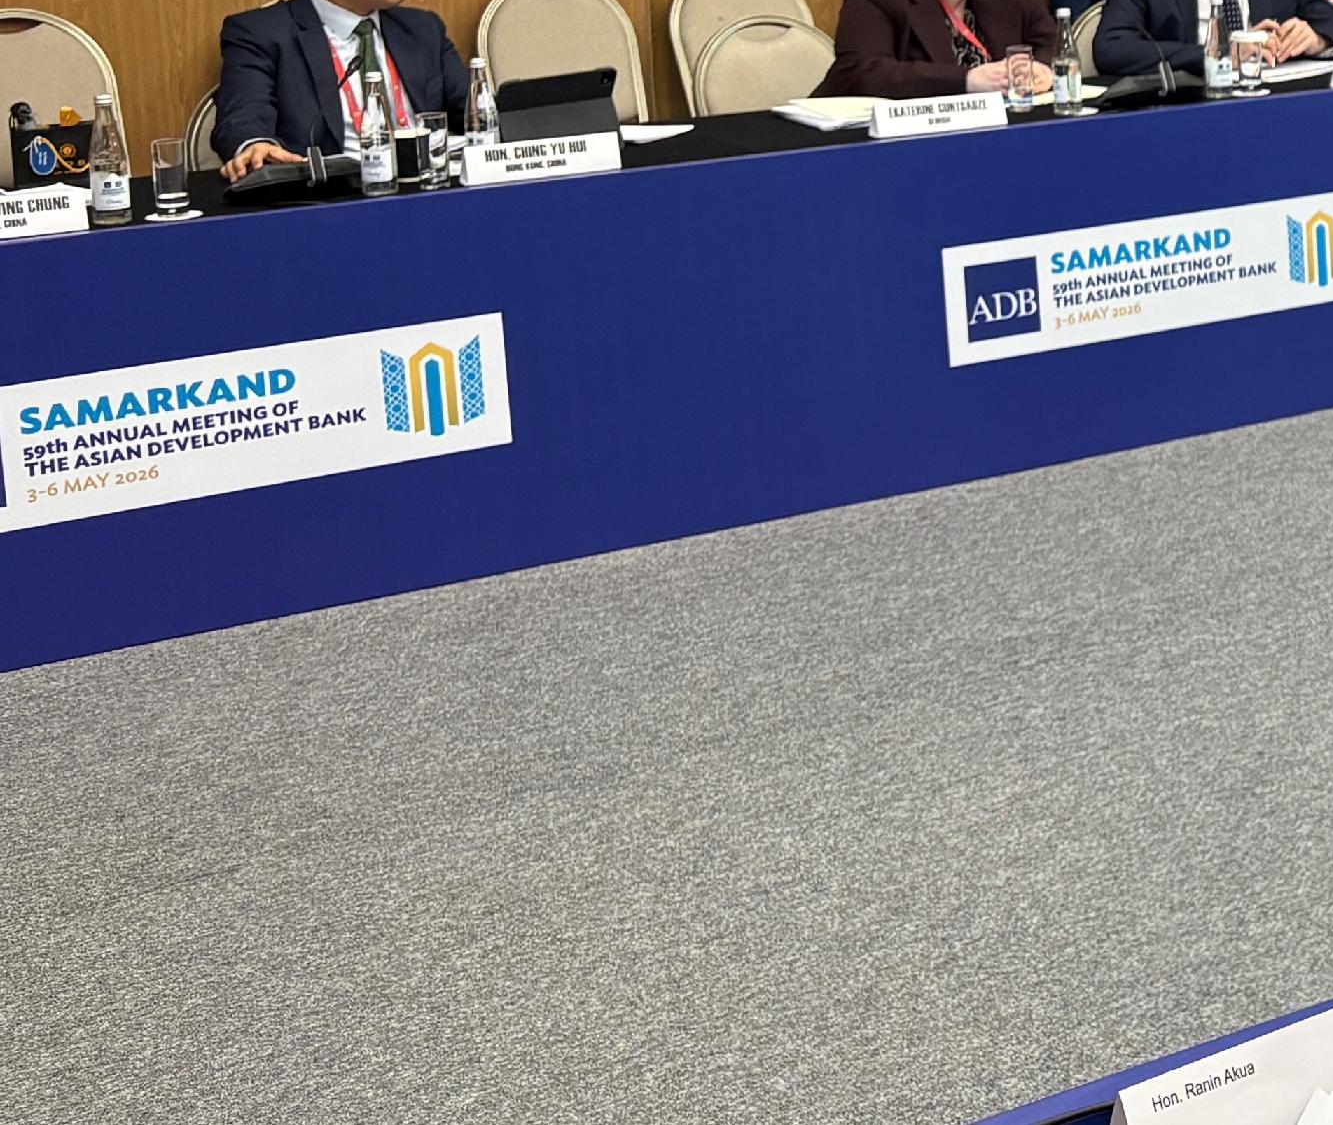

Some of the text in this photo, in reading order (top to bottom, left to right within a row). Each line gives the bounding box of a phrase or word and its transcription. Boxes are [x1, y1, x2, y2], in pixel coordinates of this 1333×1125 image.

[514, 144, 547, 159] CHING
[550, 142, 565, 155] YU
[569, 140, 587, 153] HUI
[0, 195, 70, 216] ING CHUNG
[1050, 227, 1231, 274] SAMARKAND
[1052, 254, 1233, 295] 59th ANNUAL MEETING OF
[1053, 261, 1277, 309] THE ASIAN DEVELOPMENT BANK
[969, 287, 1038, 325] ADB
[1077, 306, 1110, 323] MAY
[19, 368, 297, 435] SAMARKAND
[23, 400, 299, 462] 59th ANNUAL MEETING OF
[24, 407, 367, 477] THE ASIAN DEVELOPMENT BANK
[27, 465, 160, 504] 3-6 MAY 2026
[1151, 1063, 1255, 1112] Hon. Ranin Akua
